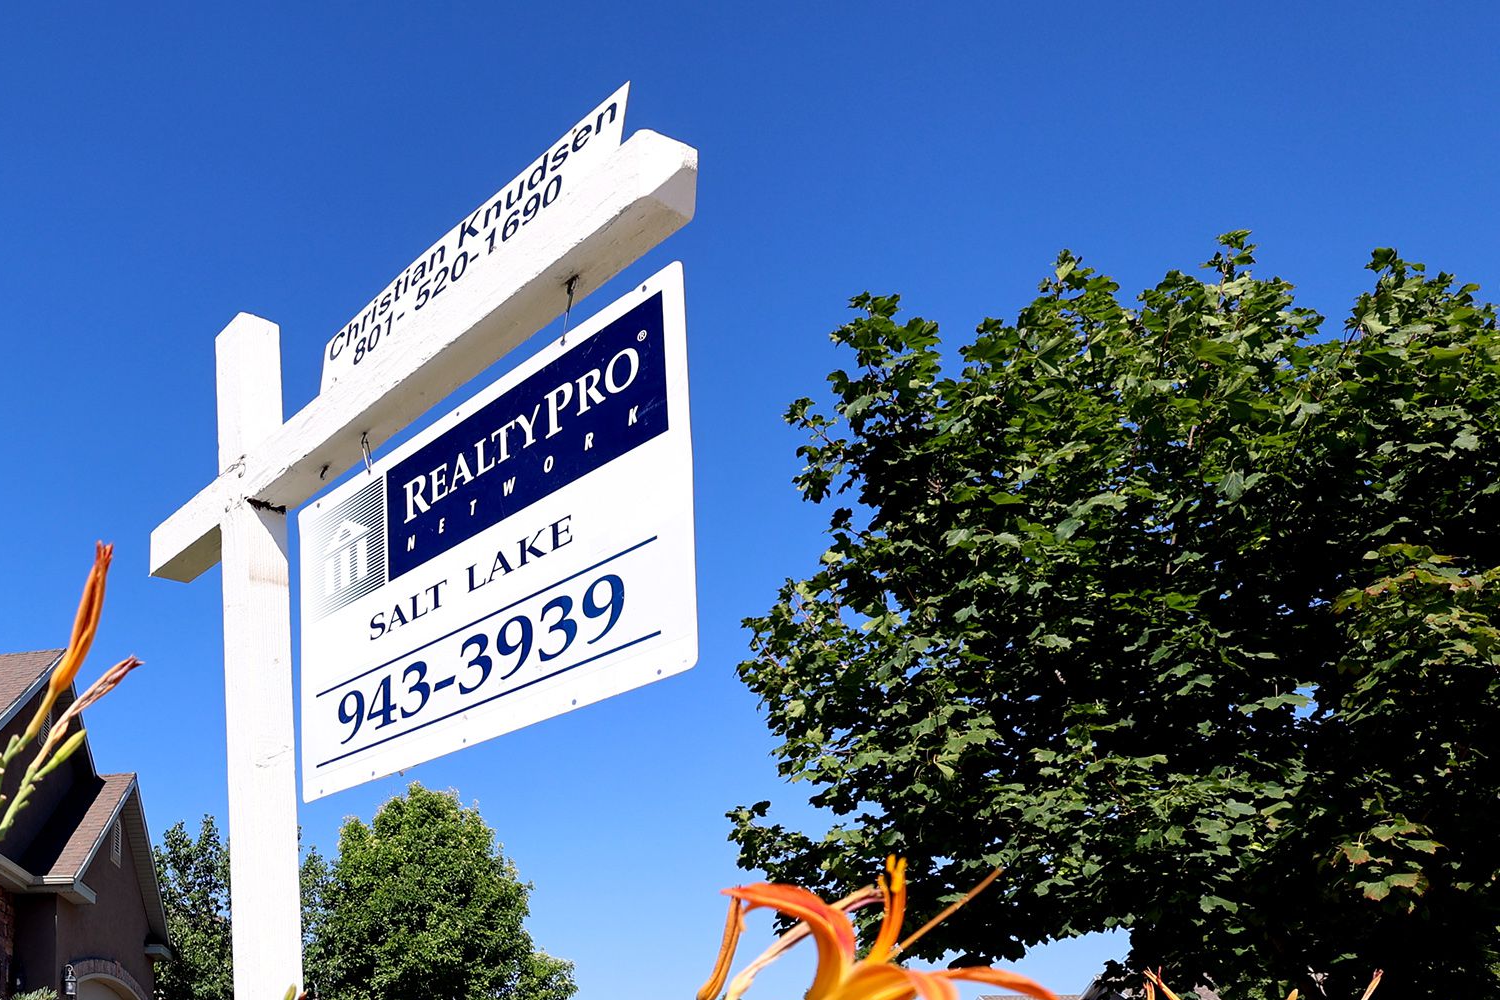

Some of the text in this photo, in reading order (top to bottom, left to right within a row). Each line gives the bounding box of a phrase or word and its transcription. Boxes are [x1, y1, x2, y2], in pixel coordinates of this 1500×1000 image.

[328, 101, 617, 361] Christian Knudsen
[406, 405, 639, 552] NETWORK
[369, 514, 574, 641] SALT LAKE
[337, 573, 626, 745] 943-3939
